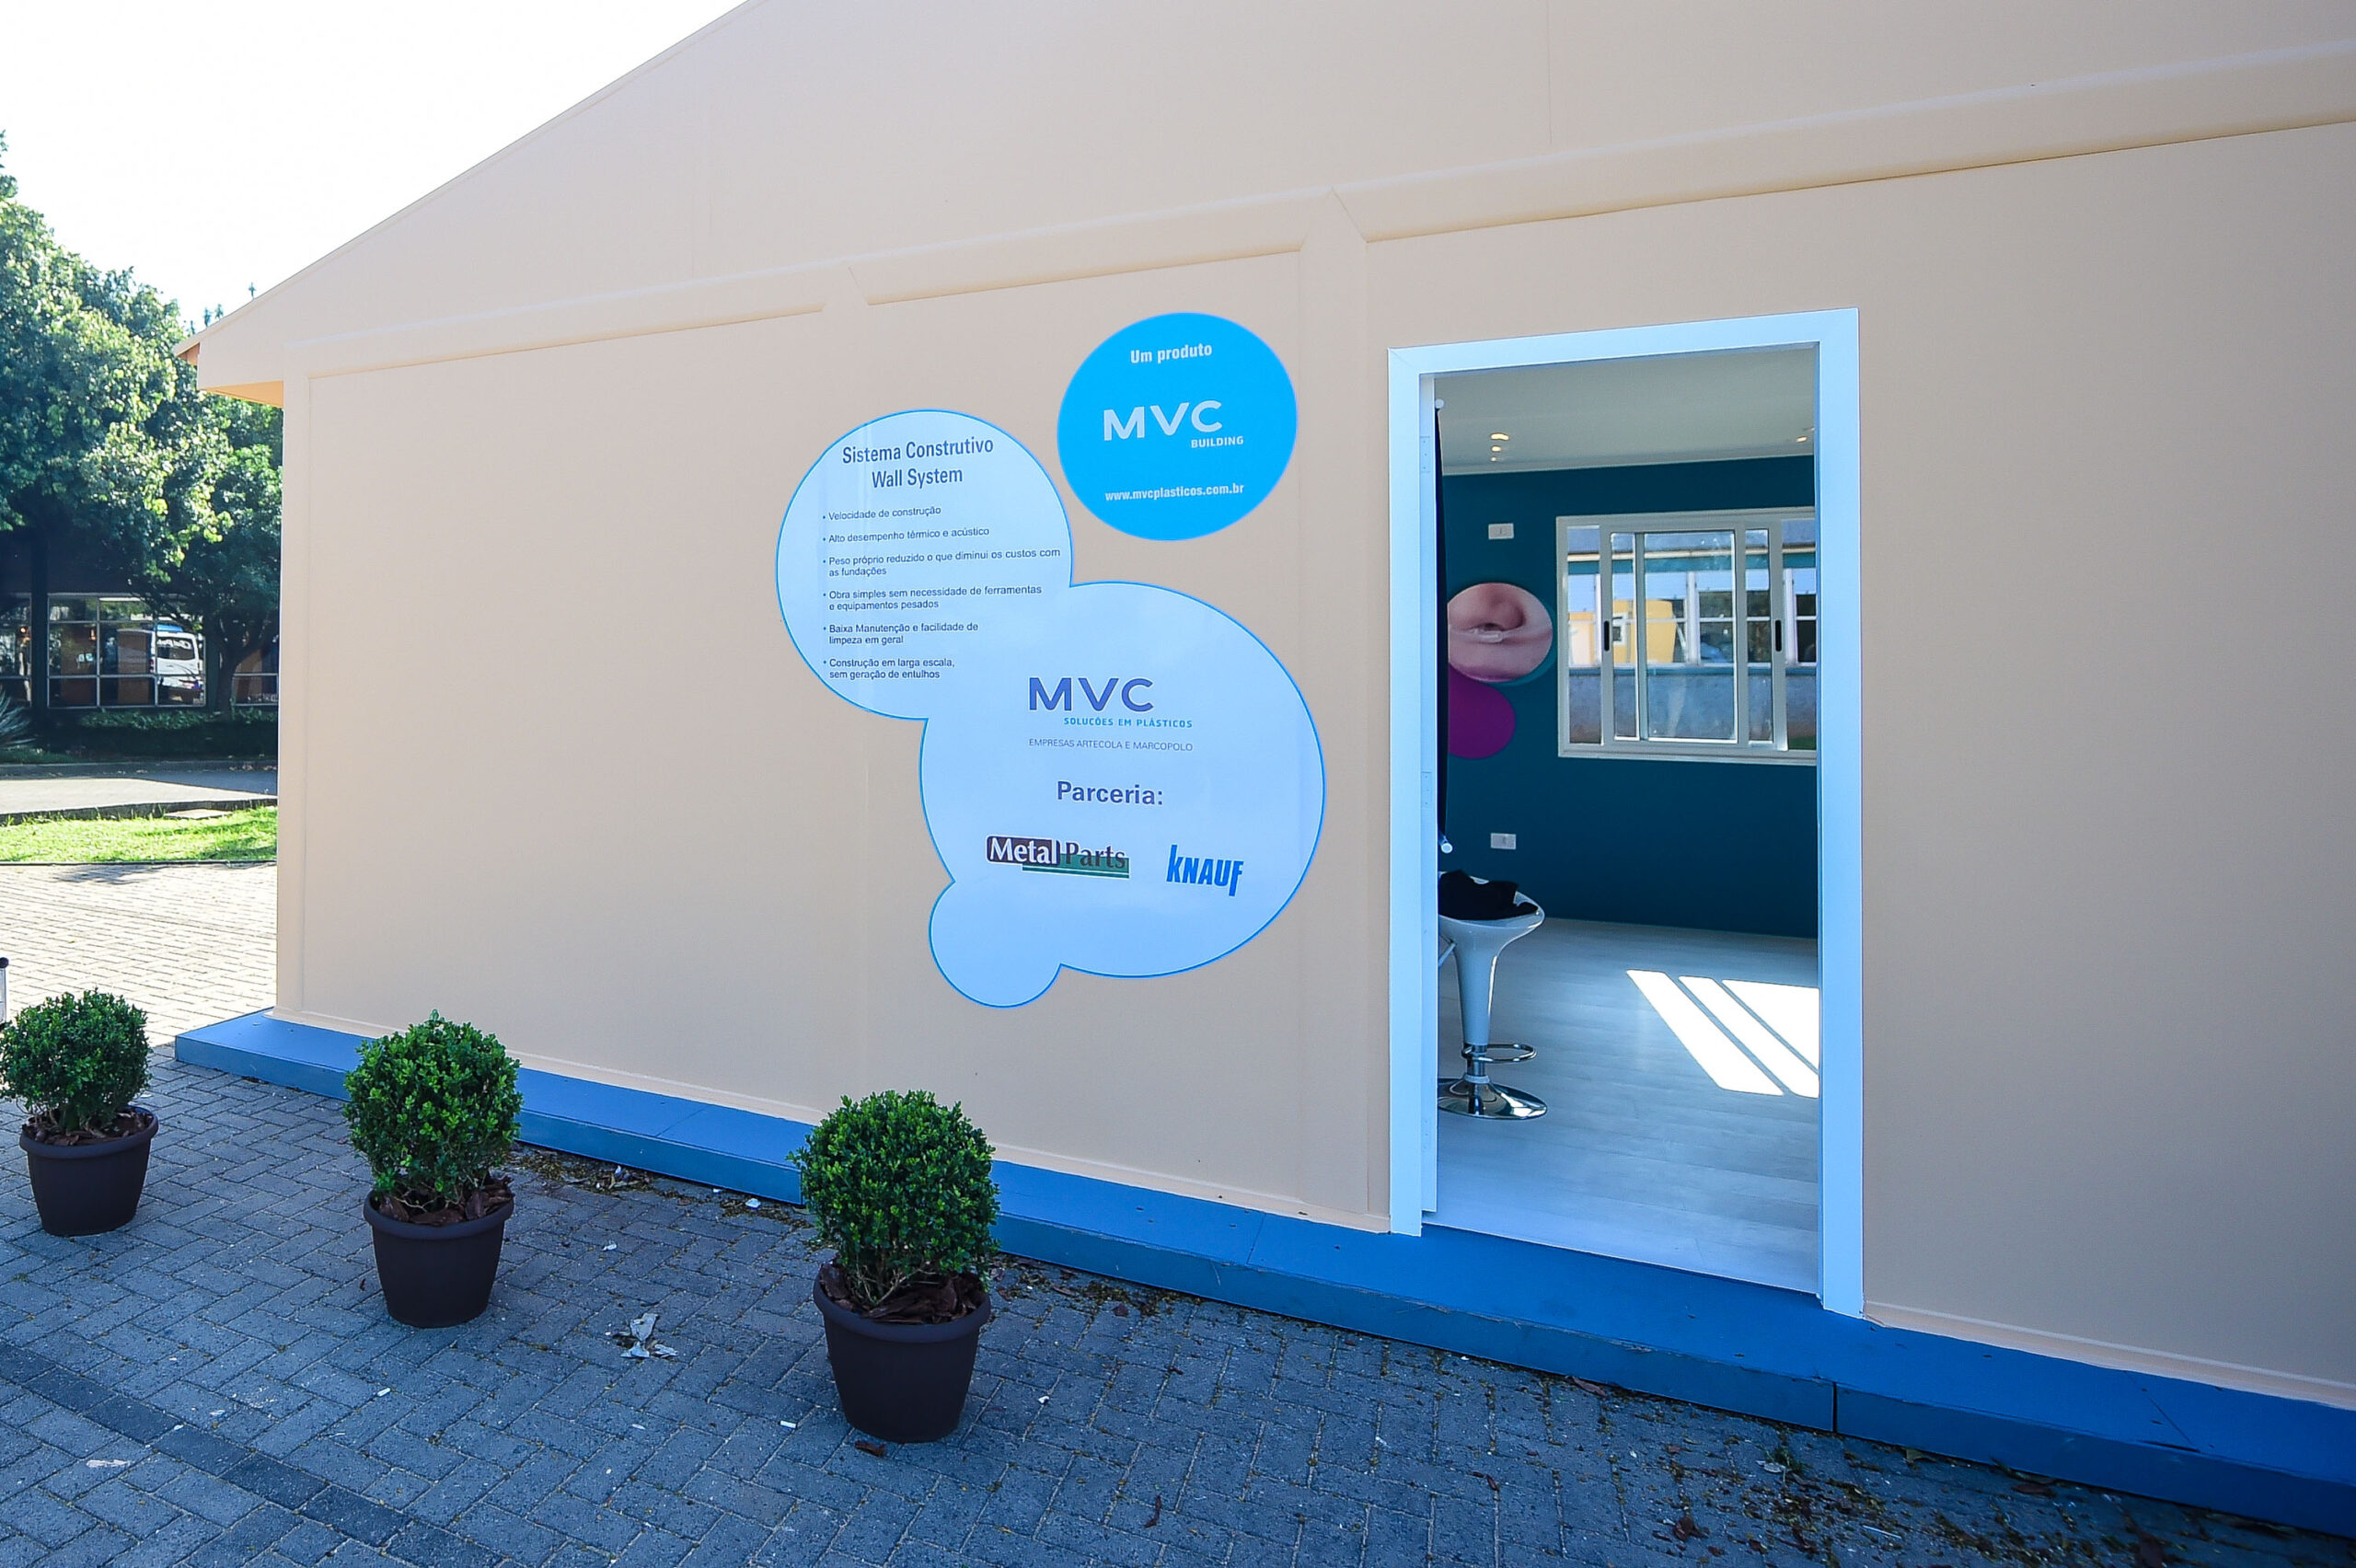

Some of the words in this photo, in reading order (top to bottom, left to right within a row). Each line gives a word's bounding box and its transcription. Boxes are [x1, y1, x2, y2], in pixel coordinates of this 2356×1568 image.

[1131, 350, 1152, 363] Um
[1157, 343, 1212, 363] produto
[1103, 400, 1222, 441] MVC
[843, 445, 901, 464] Sistema
[906, 436, 993, 459] Construtivo
[1191, 436, 1243, 448] BUILDING
[872, 470, 902, 488] Wall
[907, 467, 963, 489] System
[1105, 483, 1244, 502] www.mvcplasticos.com.br
[829, 510, 876, 521] Velocidade
[879, 510, 890, 518] de
[892, 506, 941, 518] construção
[829, 535, 845, 543] Alto
[848, 532, 905, 543] desempenho
[907, 529, 940, 539] térmico
[951, 526, 989, 536] acústico
[829, 556, 850, 566] Peso
[853, 554, 884, 566] próprio
[886, 553, 924, 563] reduzido
[935, 553, 953, 564] que
[955, 550, 988, 560] diminui
[991, 550, 1002, 559] os
[1005, 549, 1037, 559] custos
[1039, 548, 1060, 557] com
[829, 569, 839, 577] as
[841, 566, 886, 578] fundações
[829, 590, 850, 599] Obra
[853, 588, 886, 601] simples
[889, 589, 907, 597] sem
[910, 586, 967, 597] necessidade
[970, 586, 982, 595] de
[984, 585, 1042, 595] ferramentas
[837, 601, 898, 612] equipamentos
[901, 599, 939, 610] pesados
[829, 624, 853, 633] Baixa
[856, 623, 910, 634] Manutenção
[921, 623, 964, 631] facilidade
[966, 622, 978, 631] de
[829, 636, 862, 645] limpeza
[865, 636, 880, 644] em
[882, 635, 903, 646] geral
[829, 658, 880, 670] Construção
[882, 659, 895, 667] em
[897, 658, 920, 668] larga
[922, 658, 954, 668] escala,
[829, 671, 849, 679] sem
[850, 671, 885, 681] geração
[888, 670, 899, 678] de
[902, 669, 940, 678] entulhos
[1029, 677, 1153, 711] MVC
[1118, 718, 1132, 726] EM
[1137, 718, 1192, 728] PLÁSTICOS
[1029, 739, 1074, 748] EMPRESAS
[1077, 740, 1122, 749] ARTECOLA
[1133, 741, 1193, 751] MARCOPOLO
[1057, 781, 1162, 805] Parceria:
[990, 838, 1057, 864] Metal
[1066, 842, 1126, 869] Parts
